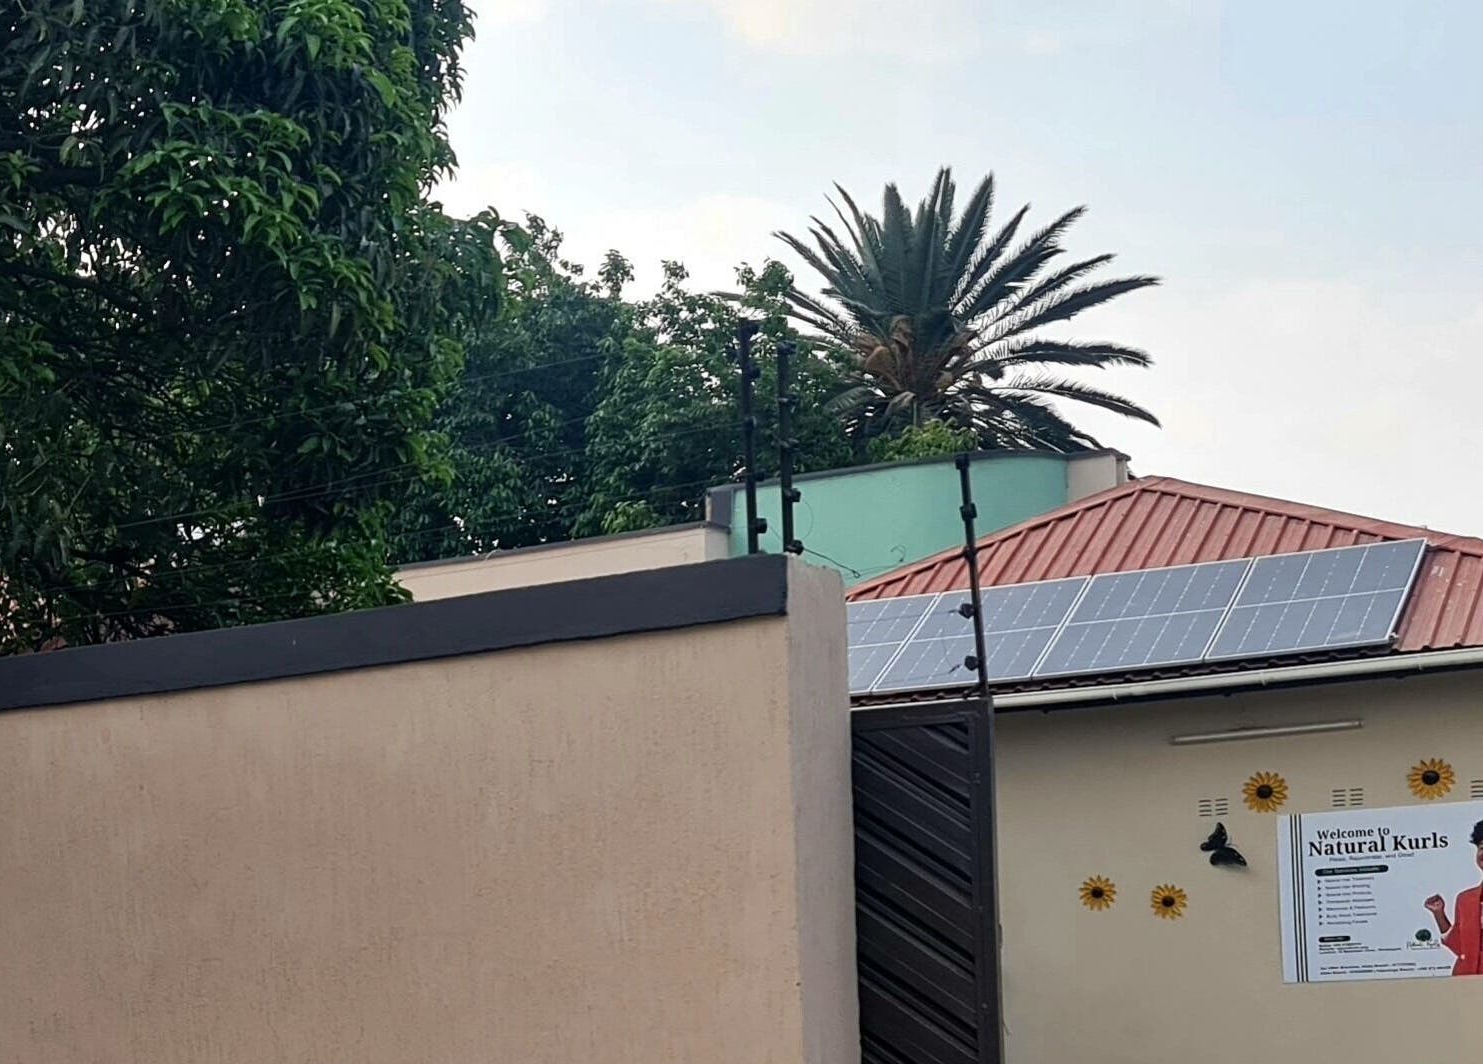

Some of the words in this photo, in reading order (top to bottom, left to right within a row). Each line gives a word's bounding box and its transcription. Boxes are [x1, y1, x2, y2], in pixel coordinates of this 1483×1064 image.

[1317, 828, 1374, 840] Welcome
[1378, 827, 1390, 837] to
[1309, 836, 1386, 857] Natural
[1392, 832, 1449, 851] Kurls
